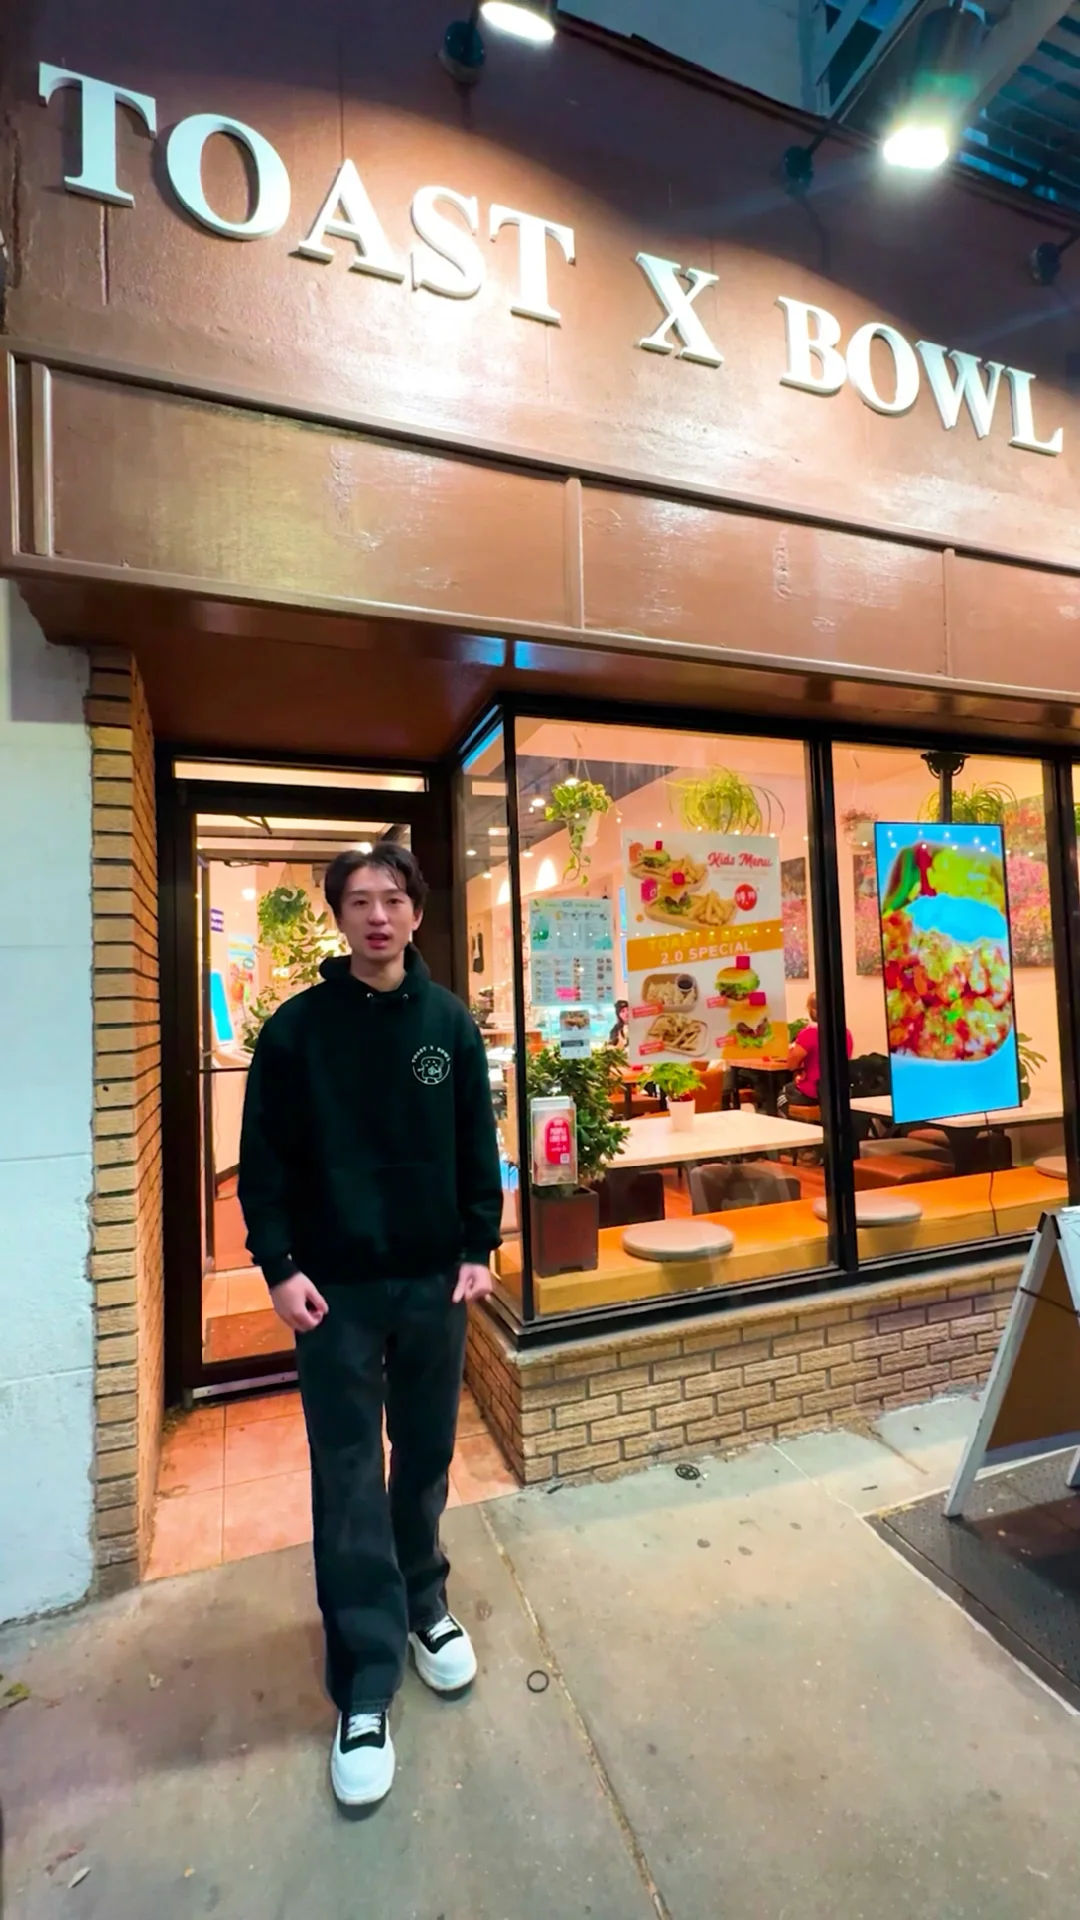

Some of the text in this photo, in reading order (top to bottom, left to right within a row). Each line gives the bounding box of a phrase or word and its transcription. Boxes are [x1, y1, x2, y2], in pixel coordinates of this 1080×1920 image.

[38, 61, 1064, 456] TOAST X BOWL
[708, 851, 773, 869] Kids Menu
[661, 940, 752, 965] 2.0 SPECIAL
